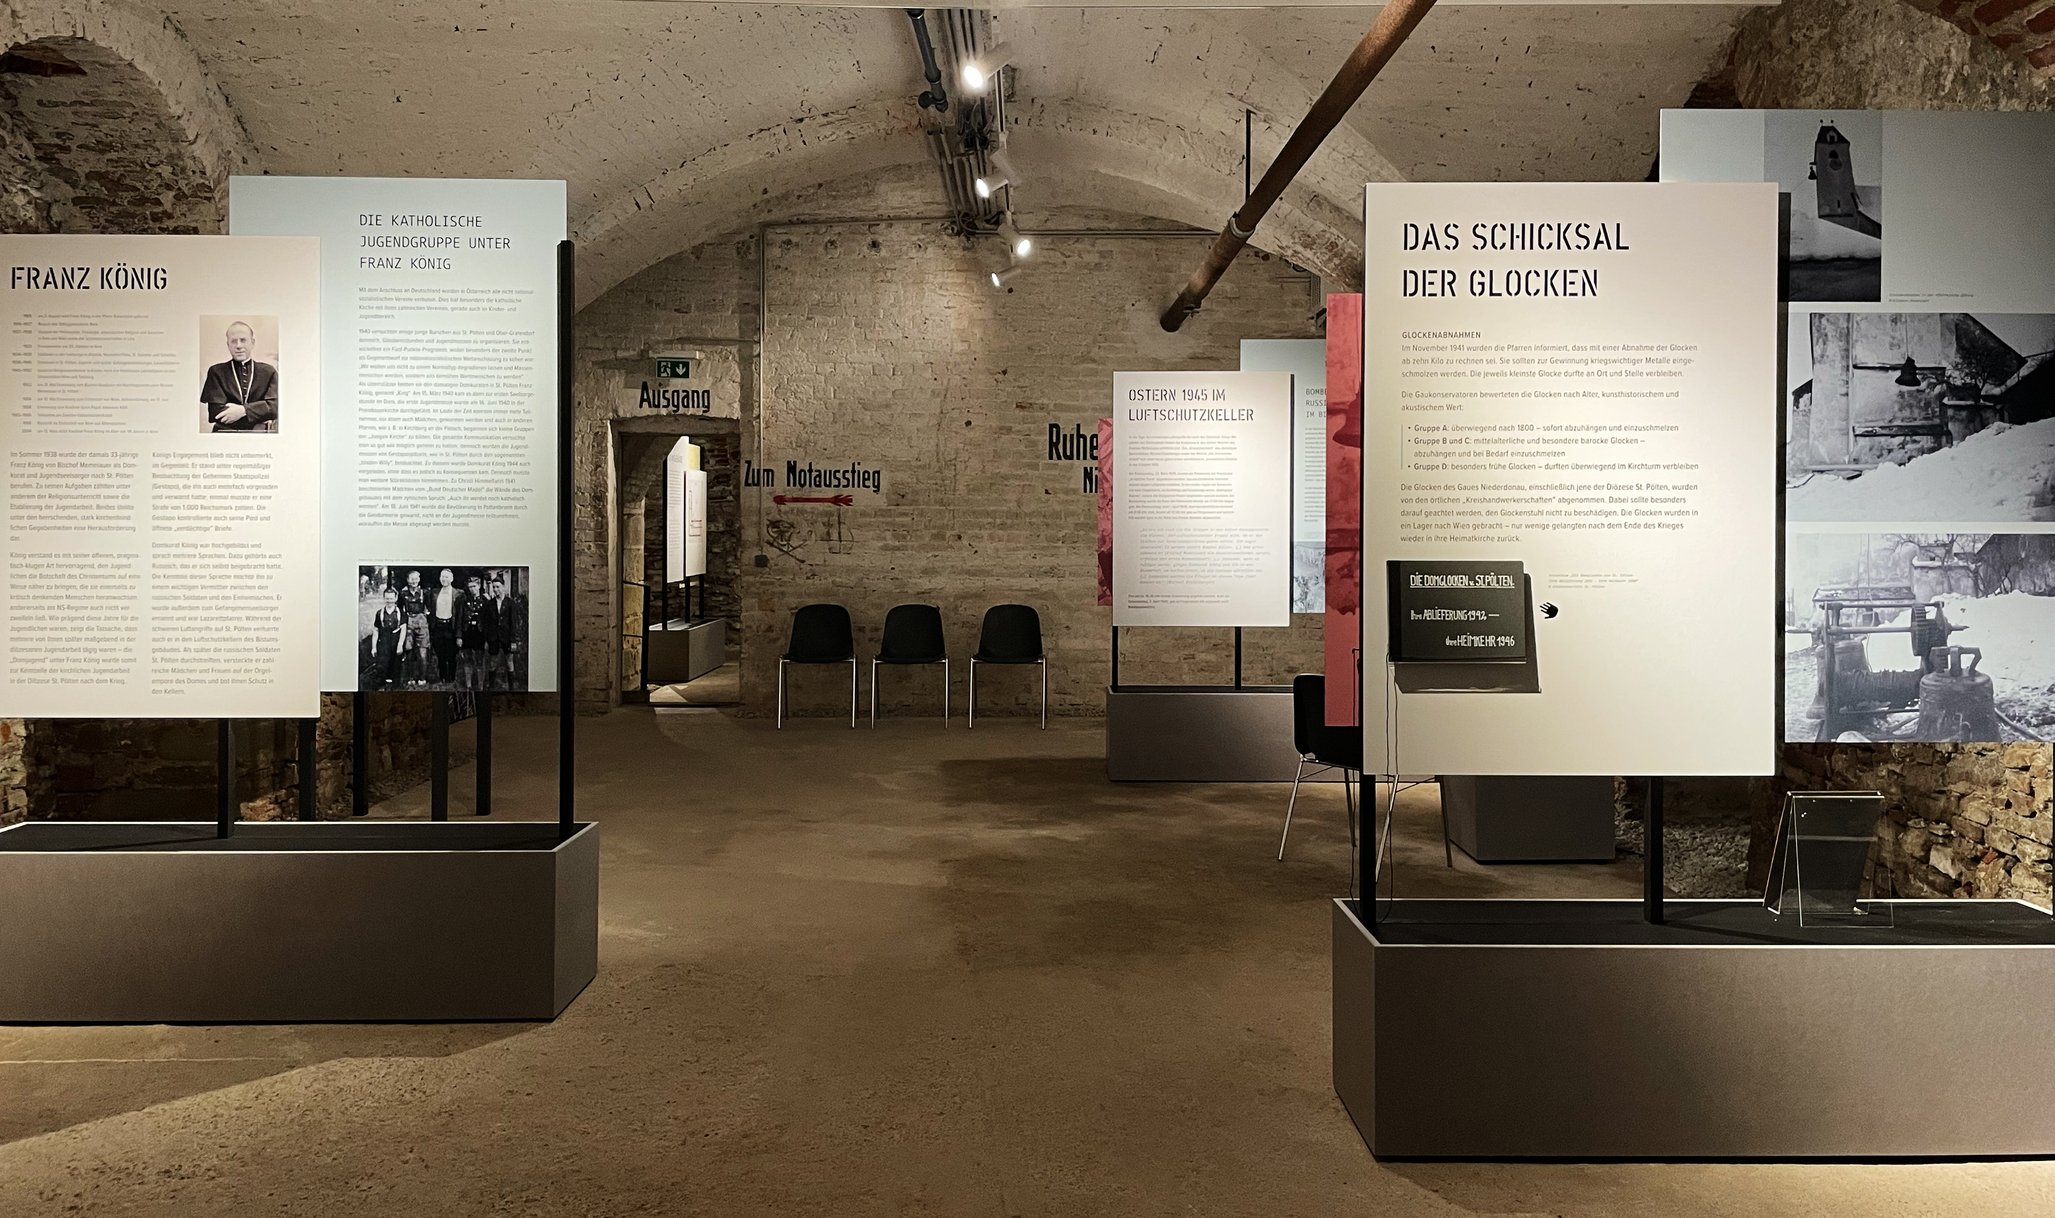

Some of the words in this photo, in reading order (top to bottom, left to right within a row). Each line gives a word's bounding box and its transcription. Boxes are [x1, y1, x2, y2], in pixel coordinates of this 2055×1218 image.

[359, 215, 382, 226] DIE
[392, 215, 483, 228] KATHOLISCHE
[1403, 223, 1459, 250] DAS
[1472, 222, 1629, 250] SCHICKSAL
[361, 236, 460, 249] JUGENDGRUPPE
[469, 237, 511, 249] UNTER
[360, 257, 402, 269] FRANZ
[410, 255, 451, 269] KÖNIG
[11, 267, 90, 289] FRANZ
[100, 263, 168, 290] KÖNIG
[1403, 270, 1457, 297] DER
[1469, 269, 1598, 297] GLOCKEN
[1402, 330, 1481, 340] GLOCKENABNAHMEN
[639, 381, 711, 414] Ausgang
[1128, 389, 1176, 401] OSTERN
[1182, 389, 1207, 401] 1945
[1212, 389, 1226, 401] IM
[1534, 390, 1562, 398] Glocken
[1128, 408, 1254, 422] LUFTSCHUTZKELLER
[1414, 424, 1440, 434] Gruppe
[1452, 425, 1496, 433] überwiegend
[1518, 424, 1534, 432] 1800
[1542, 424, 1562, 432] sofort
[1565, 424, 1607, 433] abzuhängen
[1624, 424, 1678, 432] einzuschmelzen
[1414, 437, 1440, 446] Gruppe
[1414, 450, 1456, 459] abzuhängen
[1414, 463, 1440, 471] Gruppe
[1571, 463, 1616, 471] überwiegend
[744, 460, 774, 488] Zum
[787, 460, 881, 493] Notausstieg
[1401, 509, 1422, 517] darauf
[1424, 510, 1454, 518] geachtet
[1500, 509, 1544, 517] Glockenstuhl
[1621, 509, 1632, 517] Die
[1634, 509, 1662, 517] Glocken
[1401, 521, 1411, 530] ein
[1413, 522, 1432, 531] Lager
[1472, 522, 1502, 531] gebracht
[1552, 522, 1586, 530] gelangten
[1658, 522, 1684, 530] Krieges
[1401, 535, 1424, 543] wieder
[1450, 535, 1495, 543] Heimatkirche
[1410, 572, 1423, 586] DIE
[1424, 575, 1468, 586] DOMGLOCKEN
